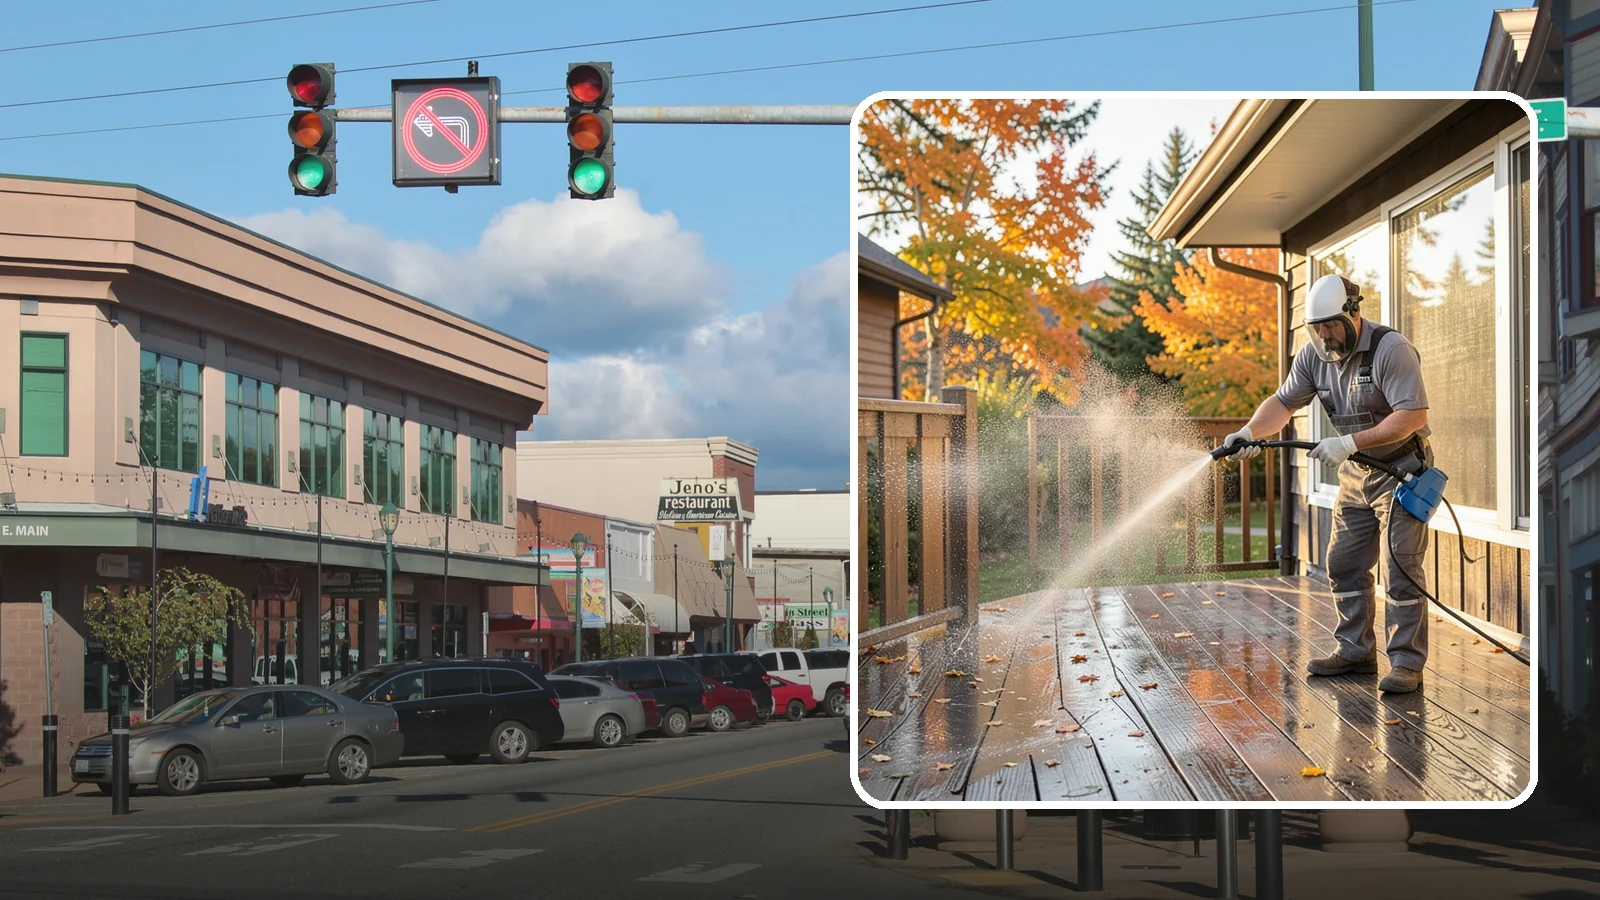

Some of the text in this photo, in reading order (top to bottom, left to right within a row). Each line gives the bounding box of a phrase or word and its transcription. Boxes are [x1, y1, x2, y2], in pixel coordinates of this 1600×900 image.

[670, 480, 727, 494] Jeno's
[665, 496, 731, 509] restaurant
[658, 509, 682, 520] Italian
[686, 509, 715, 519] American
[715, 509, 737, 519] Cuisine
[2, 525, 49, 536] E. MAIN
[797, 608, 828, 617] Street
